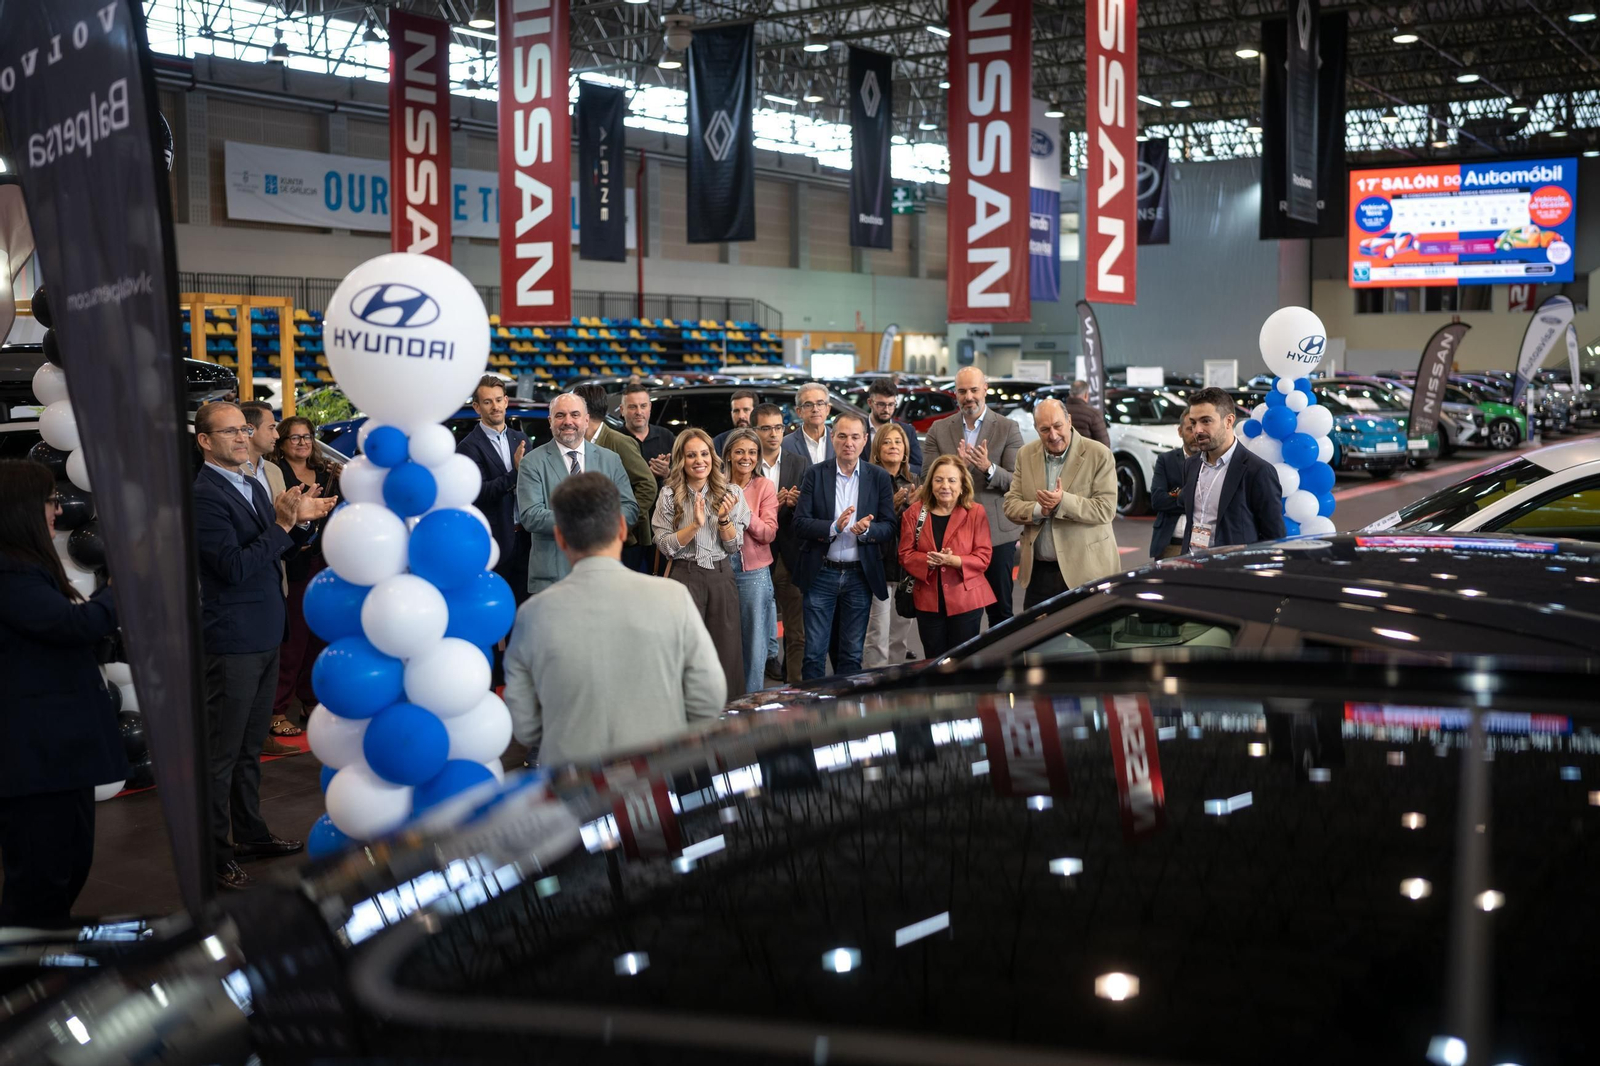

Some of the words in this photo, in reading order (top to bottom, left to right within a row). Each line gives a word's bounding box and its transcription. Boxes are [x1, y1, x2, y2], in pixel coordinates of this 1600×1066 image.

[404, 29, 439, 255] NISSA
[513, 0, 554, 306] ISSAN
[1097, 0, 1125, 293] SSAN
[1381, 173, 1439, 191] SALÓN
[1443, 175, 1462, 187] DO
[1464, 165, 1563, 187] Automóbil
[334, 327, 454, 361] HYUNDAI
[1423, 333, 1454, 413] NISSAN
